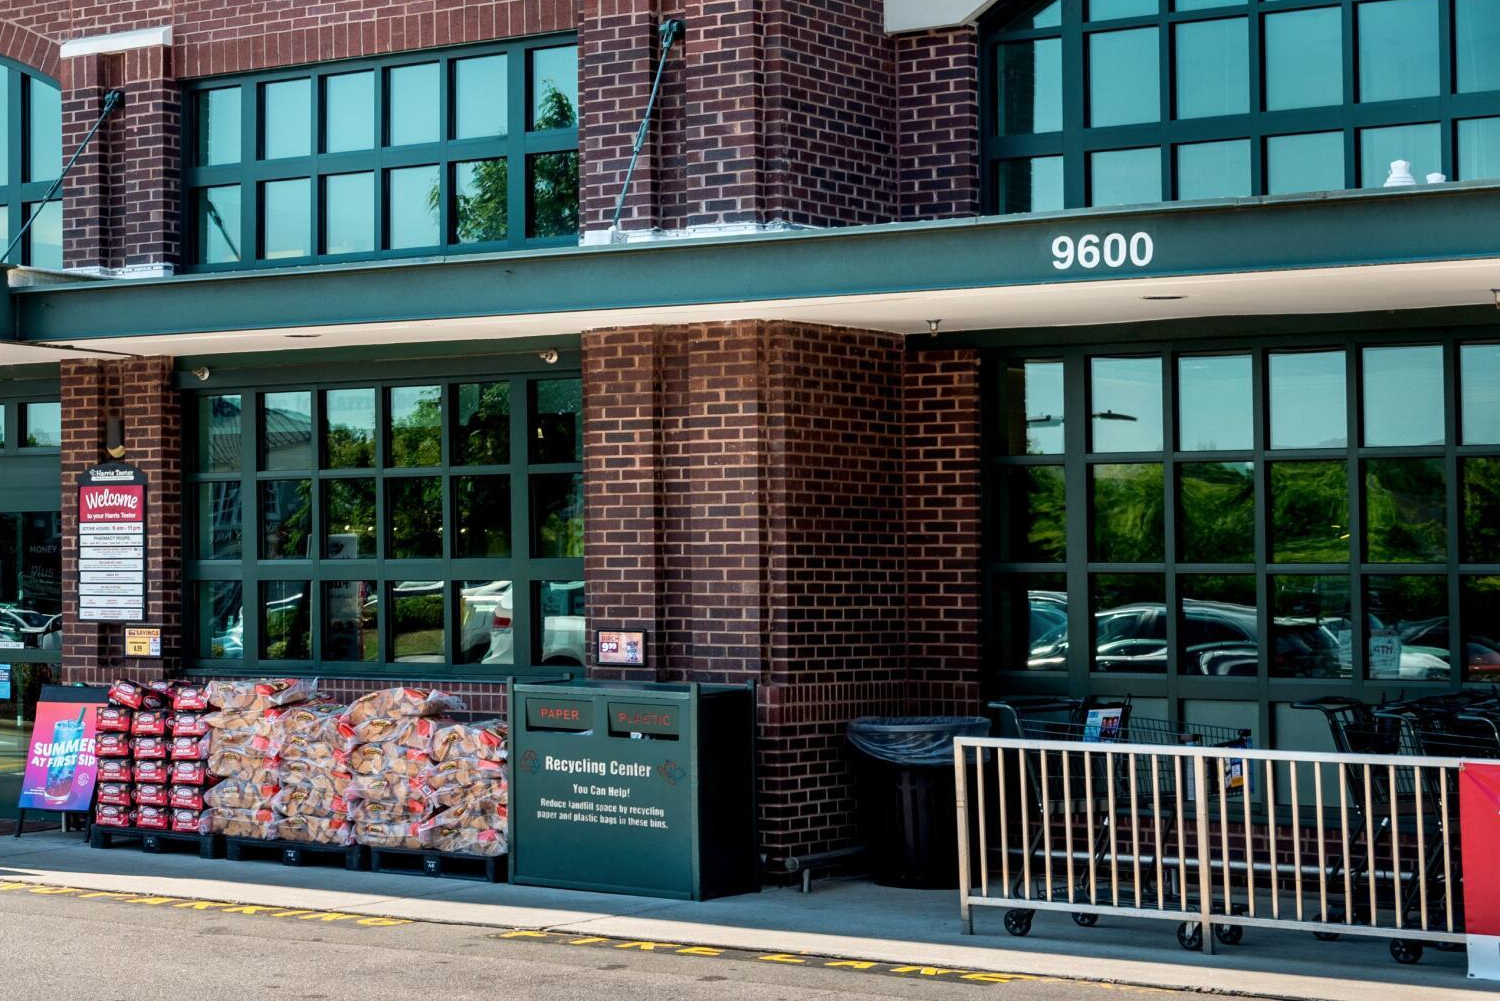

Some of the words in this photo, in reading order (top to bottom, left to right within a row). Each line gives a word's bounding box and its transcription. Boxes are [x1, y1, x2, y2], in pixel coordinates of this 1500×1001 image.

[1051, 231, 1154, 270] 9600
[86, 488, 138, 510] Welcome
[30, 545, 58, 553] MONEY
[540, 708, 580, 720] PAPER
[618, 712, 671, 726] PLASTIC
[34, 739, 96, 756] SUMMER
[31, 756, 46, 767] AT
[47, 754, 77, 767] FIRST
[78, 754, 95, 766] SIP
[545, 756, 606, 776] Recycling
[610, 760, 651, 777] Center
[573, 784, 588, 794] You
[590, 785, 606, 796] Can
[608, 787, 630, 798] Help!
[540, 798, 566, 808] Reduce
[569, 800, 594, 810] landfill
[596, 803, 616, 813] space
[619, 804, 627, 814] by
[630, 806, 664, 817] recycling
[537, 811, 556, 819] paper
[559, 811, 572, 820] and
[574, 812, 598, 823] plastic
[600, 814, 617, 825] bags
[619, 815, 626, 824] in
[628, 816, 648, 827] these
[650, 818, 668, 829] bins.
[86, 891, 414, 926] PARKING
[500, 930, 726, 956] FIRE
[758, 953, 1032, 984] LANE
